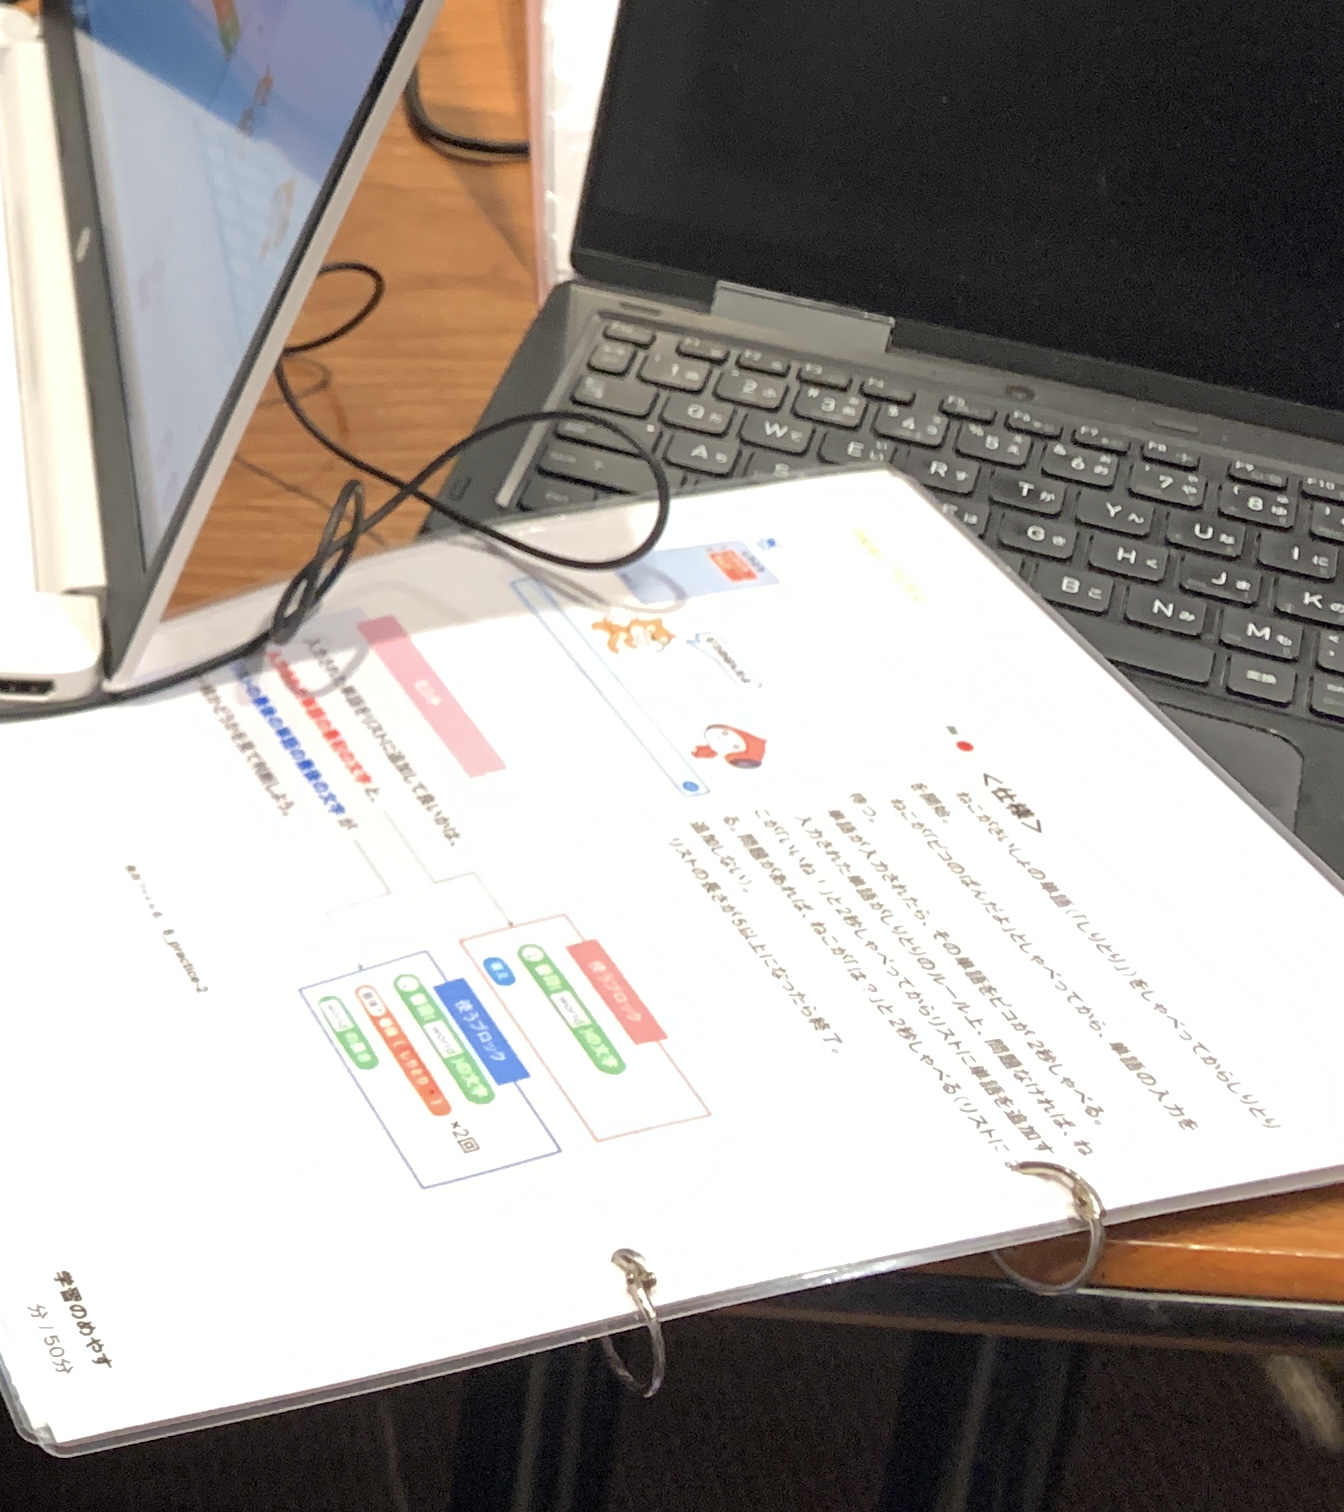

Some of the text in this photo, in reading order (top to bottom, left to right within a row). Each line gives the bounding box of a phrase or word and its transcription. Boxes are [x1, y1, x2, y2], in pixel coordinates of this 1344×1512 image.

[742, 379, 758, 395] 2
[821, 397, 836, 412] 3
[764, 421, 788, 438] W
[689, 445, 708, 460] A
[848, 441, 864, 458] E
[930, 460, 948, 477] R
[1071, 455, 1085, 471] 6
[1018, 480, 1034, 497] T
[1159, 475, 1173, 489] 7
[1106, 502, 1122, 518] Y
[1248, 496, 1263, 511] 8
[1194, 523, 1213, 539] U
[1117, 547, 1137, 565] H
[1062, 576, 1080, 594] B
[1212, 571, 1227, 586] J
[1152, 598, 1174, 618] N
[1303, 591, 1323, 610] K
[1246, 622, 1271, 641] M
[453, 998, 507, 1063] 使うブロック
[53, 1270, 113, 1369] 学習のめやす
[44, 1334, 74, 1374] 50分
